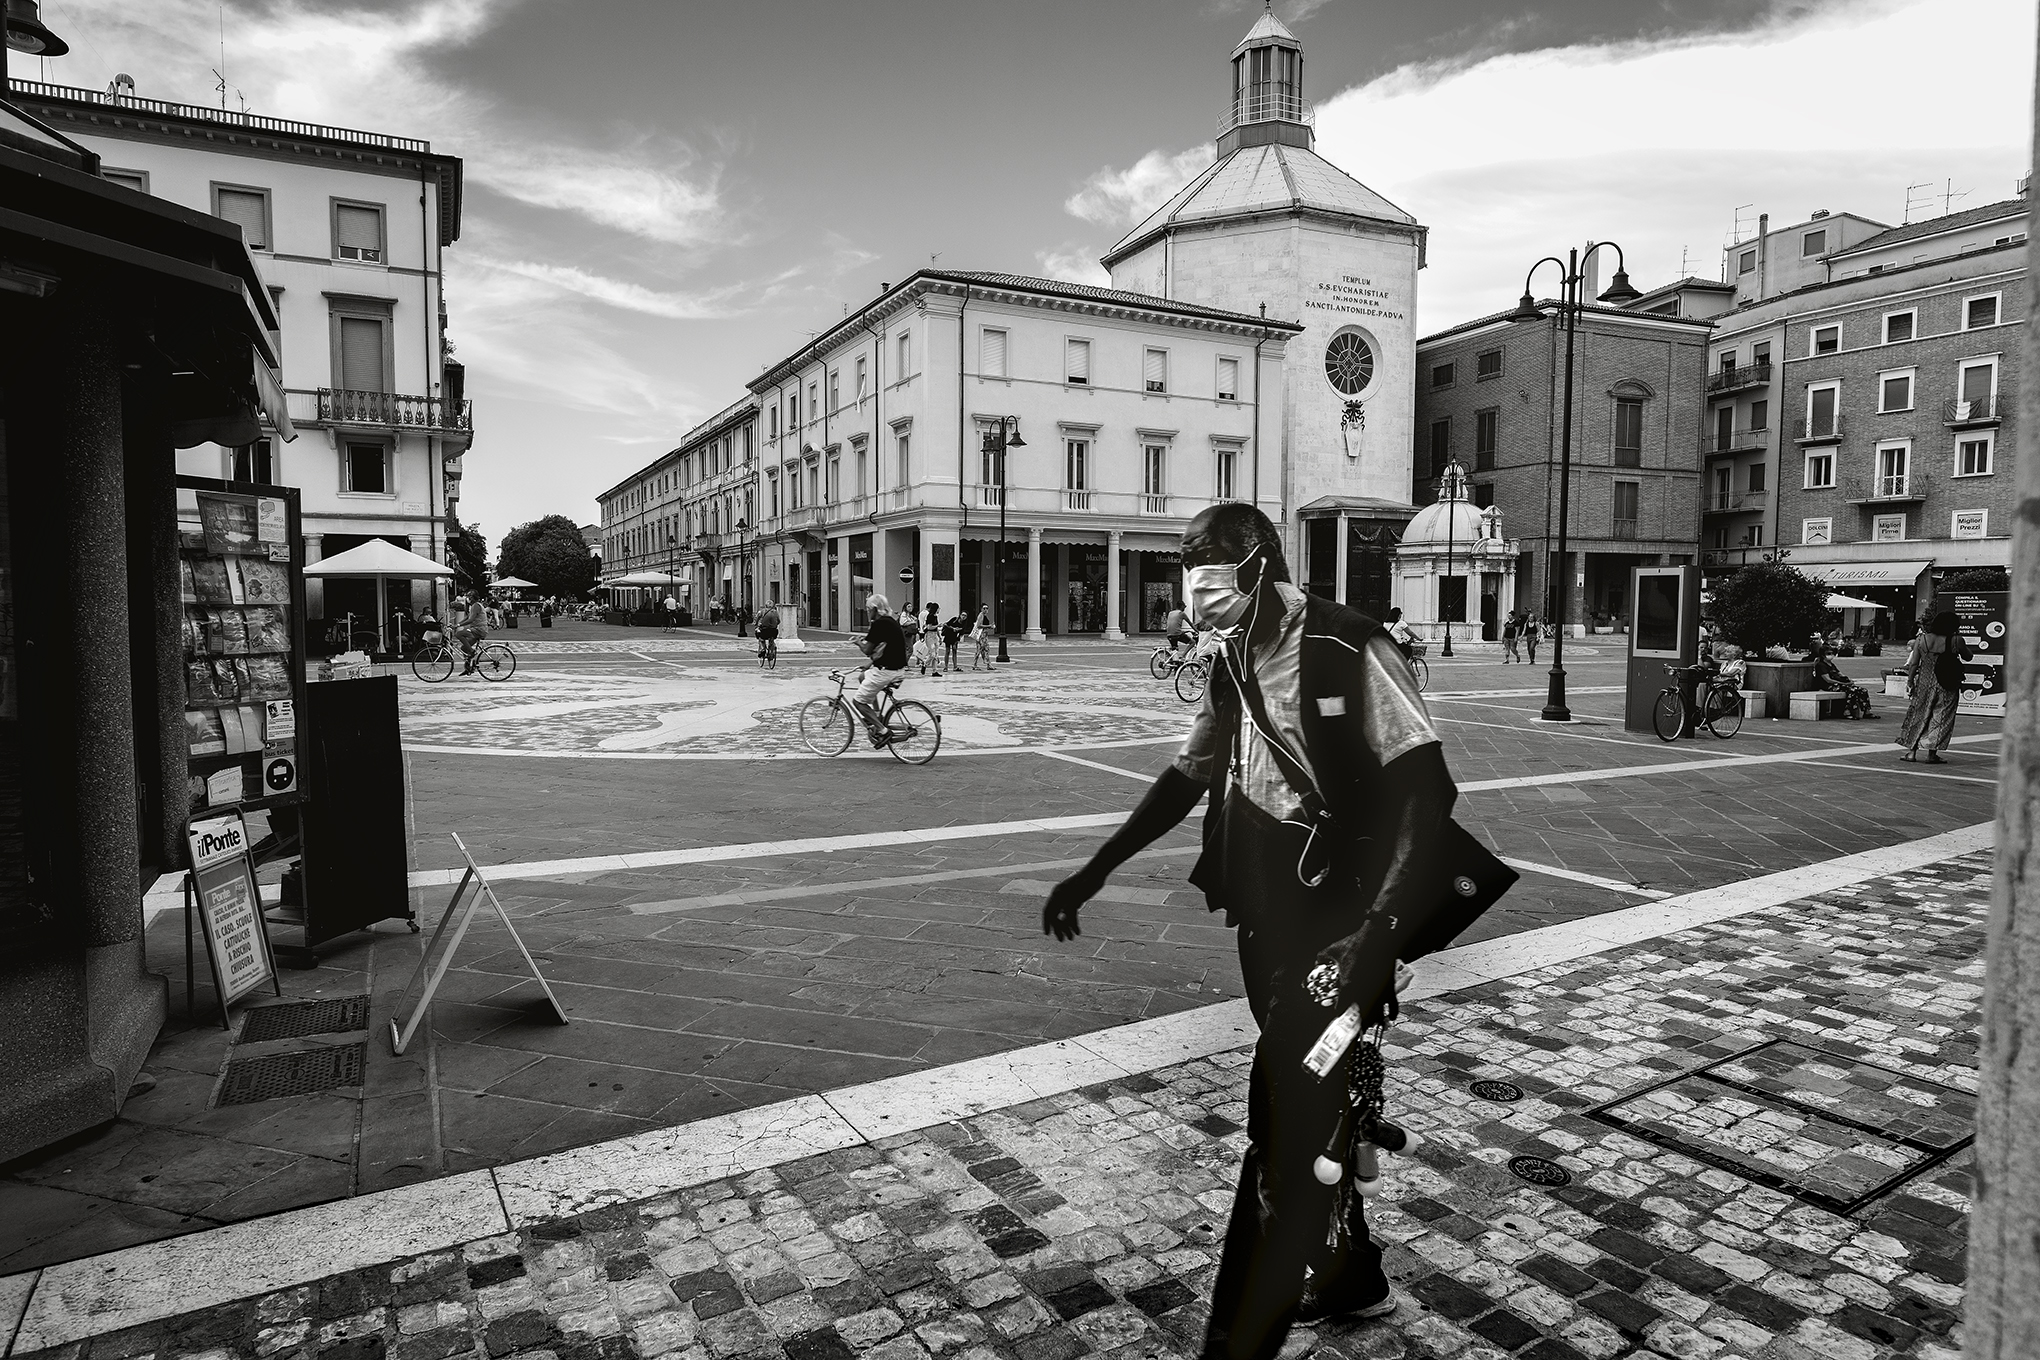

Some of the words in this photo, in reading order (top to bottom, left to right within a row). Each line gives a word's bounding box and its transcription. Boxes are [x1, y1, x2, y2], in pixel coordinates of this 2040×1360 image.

[1342, 275, 1371, 286] TEMPLUM
[1879, 522, 1902, 530] Migliori
[1958, 517, 1983, 525] Migliori
[1155, 555, 1181, 564] MaxMara
[1832, 570, 1889, 580] TURISMO
[276, 748, 294, 756] ticket
[211, 888, 231, 904] Ponte
[214, 928, 221, 940] IL
[235, 912, 253, 930] SCUOLE
[223, 927, 251, 950] CATTOLICHE
[228, 951, 233, 962] A
[232, 941, 252, 960] RISCHIO
[230, 953, 255, 975] CHIUSURA
